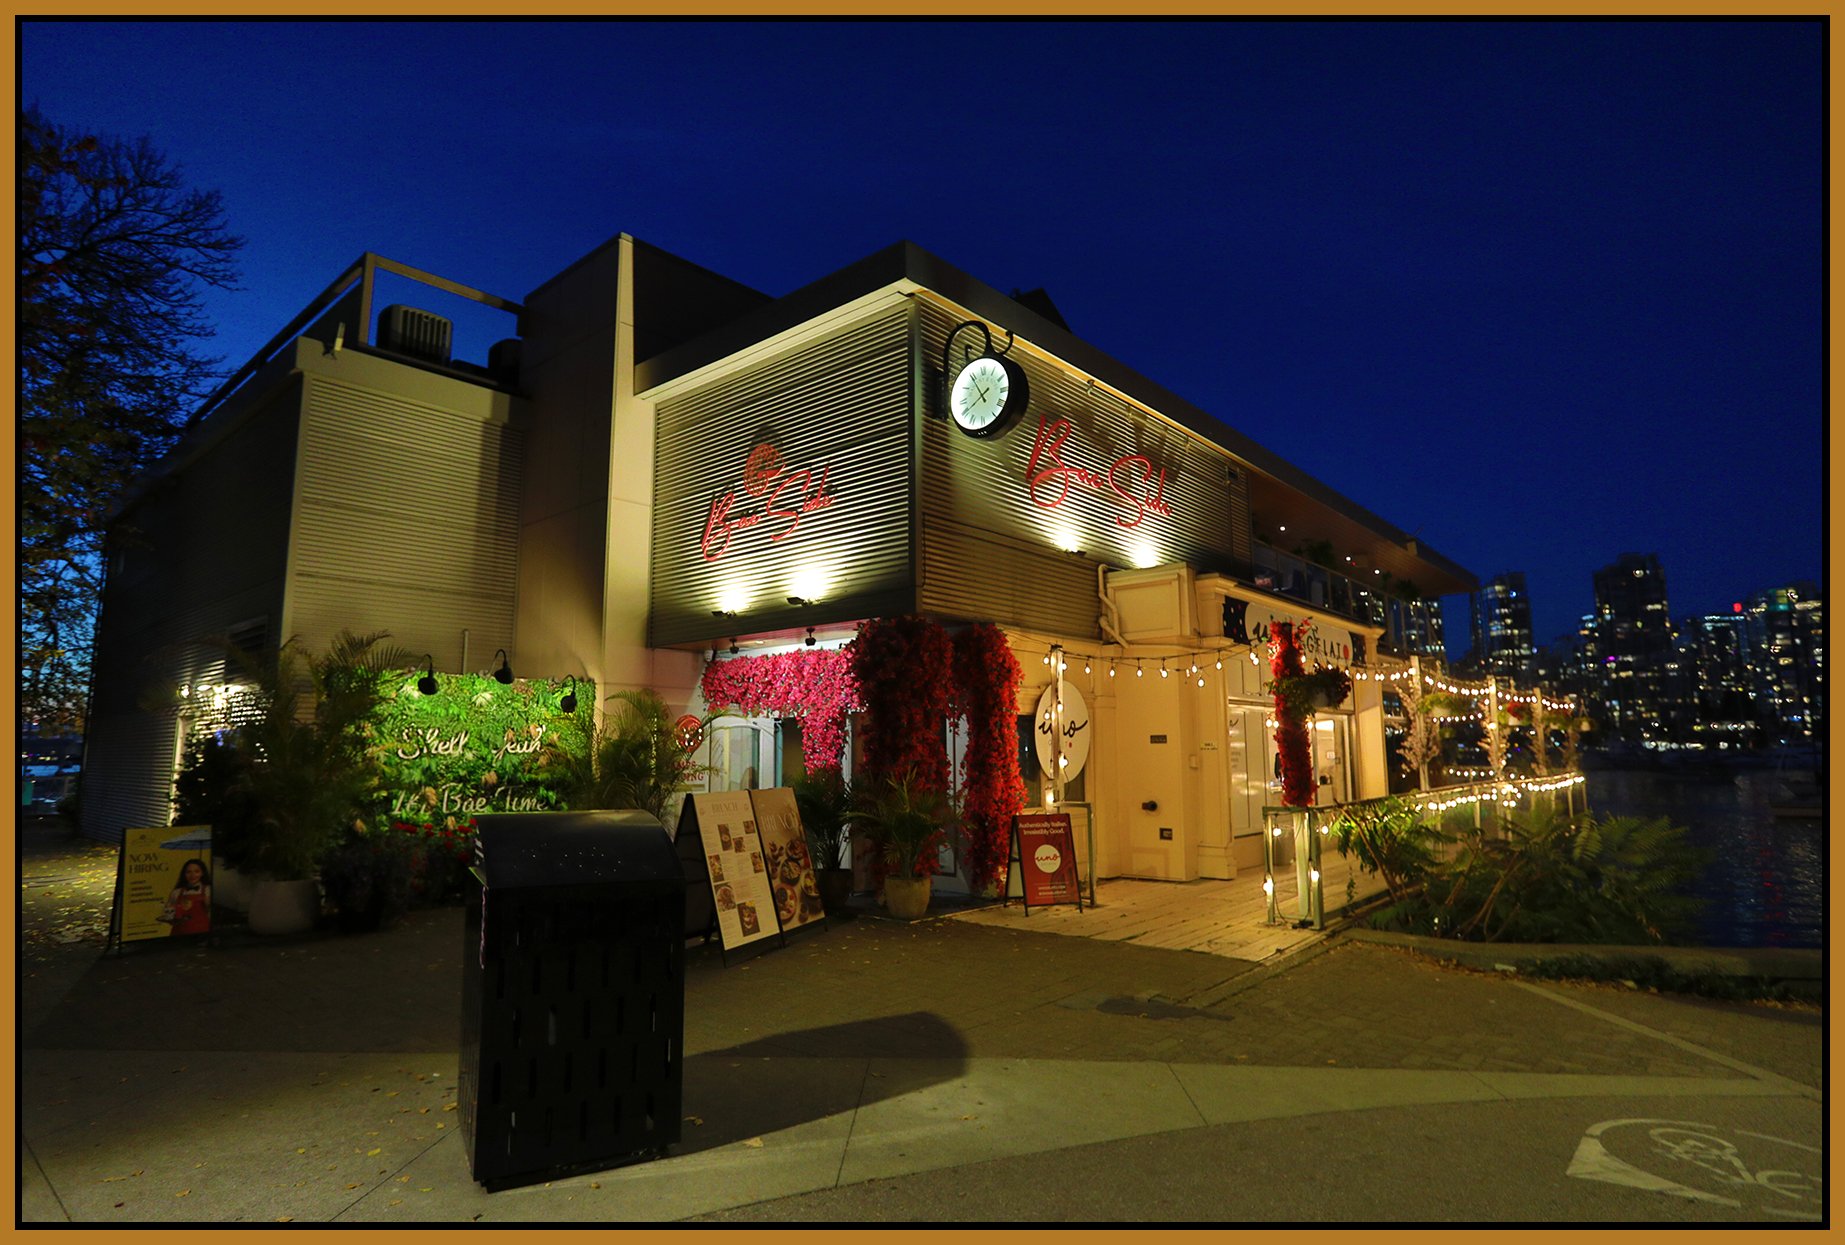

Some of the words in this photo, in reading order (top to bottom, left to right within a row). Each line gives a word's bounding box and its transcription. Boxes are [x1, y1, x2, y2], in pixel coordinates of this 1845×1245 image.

[1025, 413, 1104, 508] Bae
[1108, 455, 1173, 528] Side
[701, 492, 762, 562] Bae
[766, 464, 836, 541] Side
[442, 782, 488, 815] Bae
[128, 852, 158, 863] NOW
[128, 862, 169, 874] HIRING
[1035, 853, 1060, 862] uno
